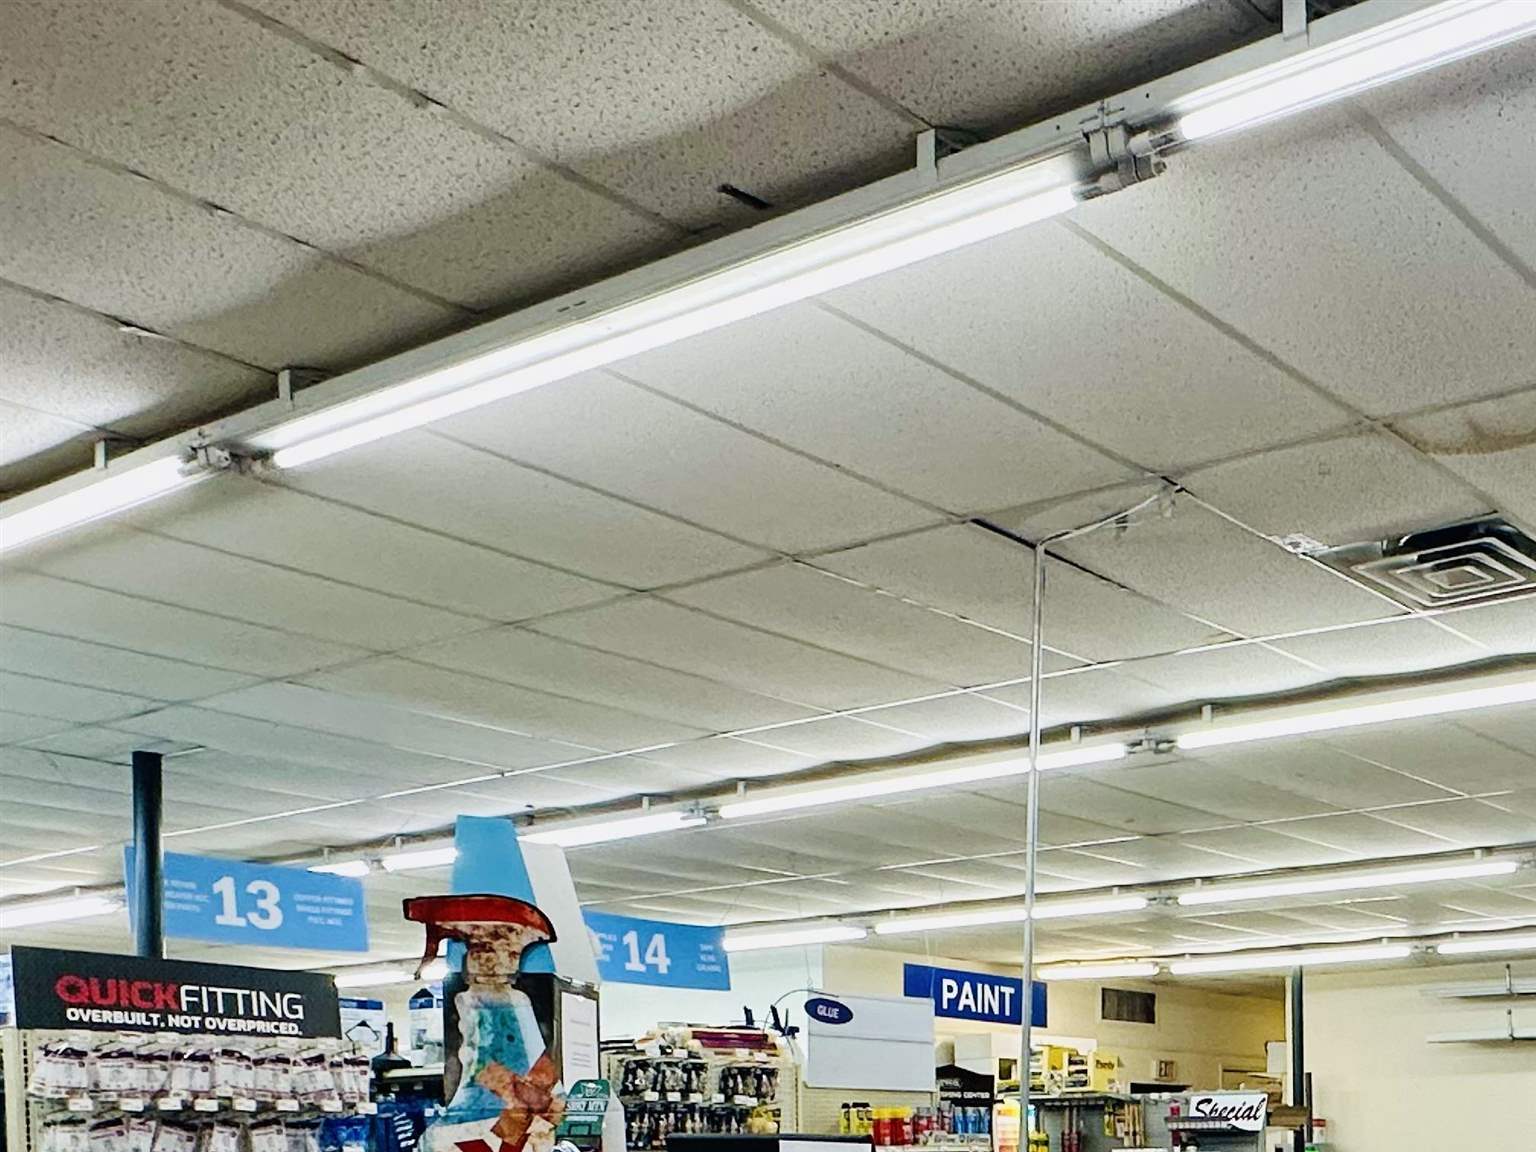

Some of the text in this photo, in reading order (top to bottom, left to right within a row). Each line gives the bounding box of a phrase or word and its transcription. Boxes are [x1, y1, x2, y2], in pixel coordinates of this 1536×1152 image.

[212, 876, 284, 930] 13
[622, 930, 671, 974] 14
[54, 974, 304, 1019] QUICKFITTING
[817, 1004, 840, 1019] GLUE
[942, 978, 1015, 1016] PAINT
[66, 1007, 303, 1035] OVERBUILT. NOT OVERPRICED.
